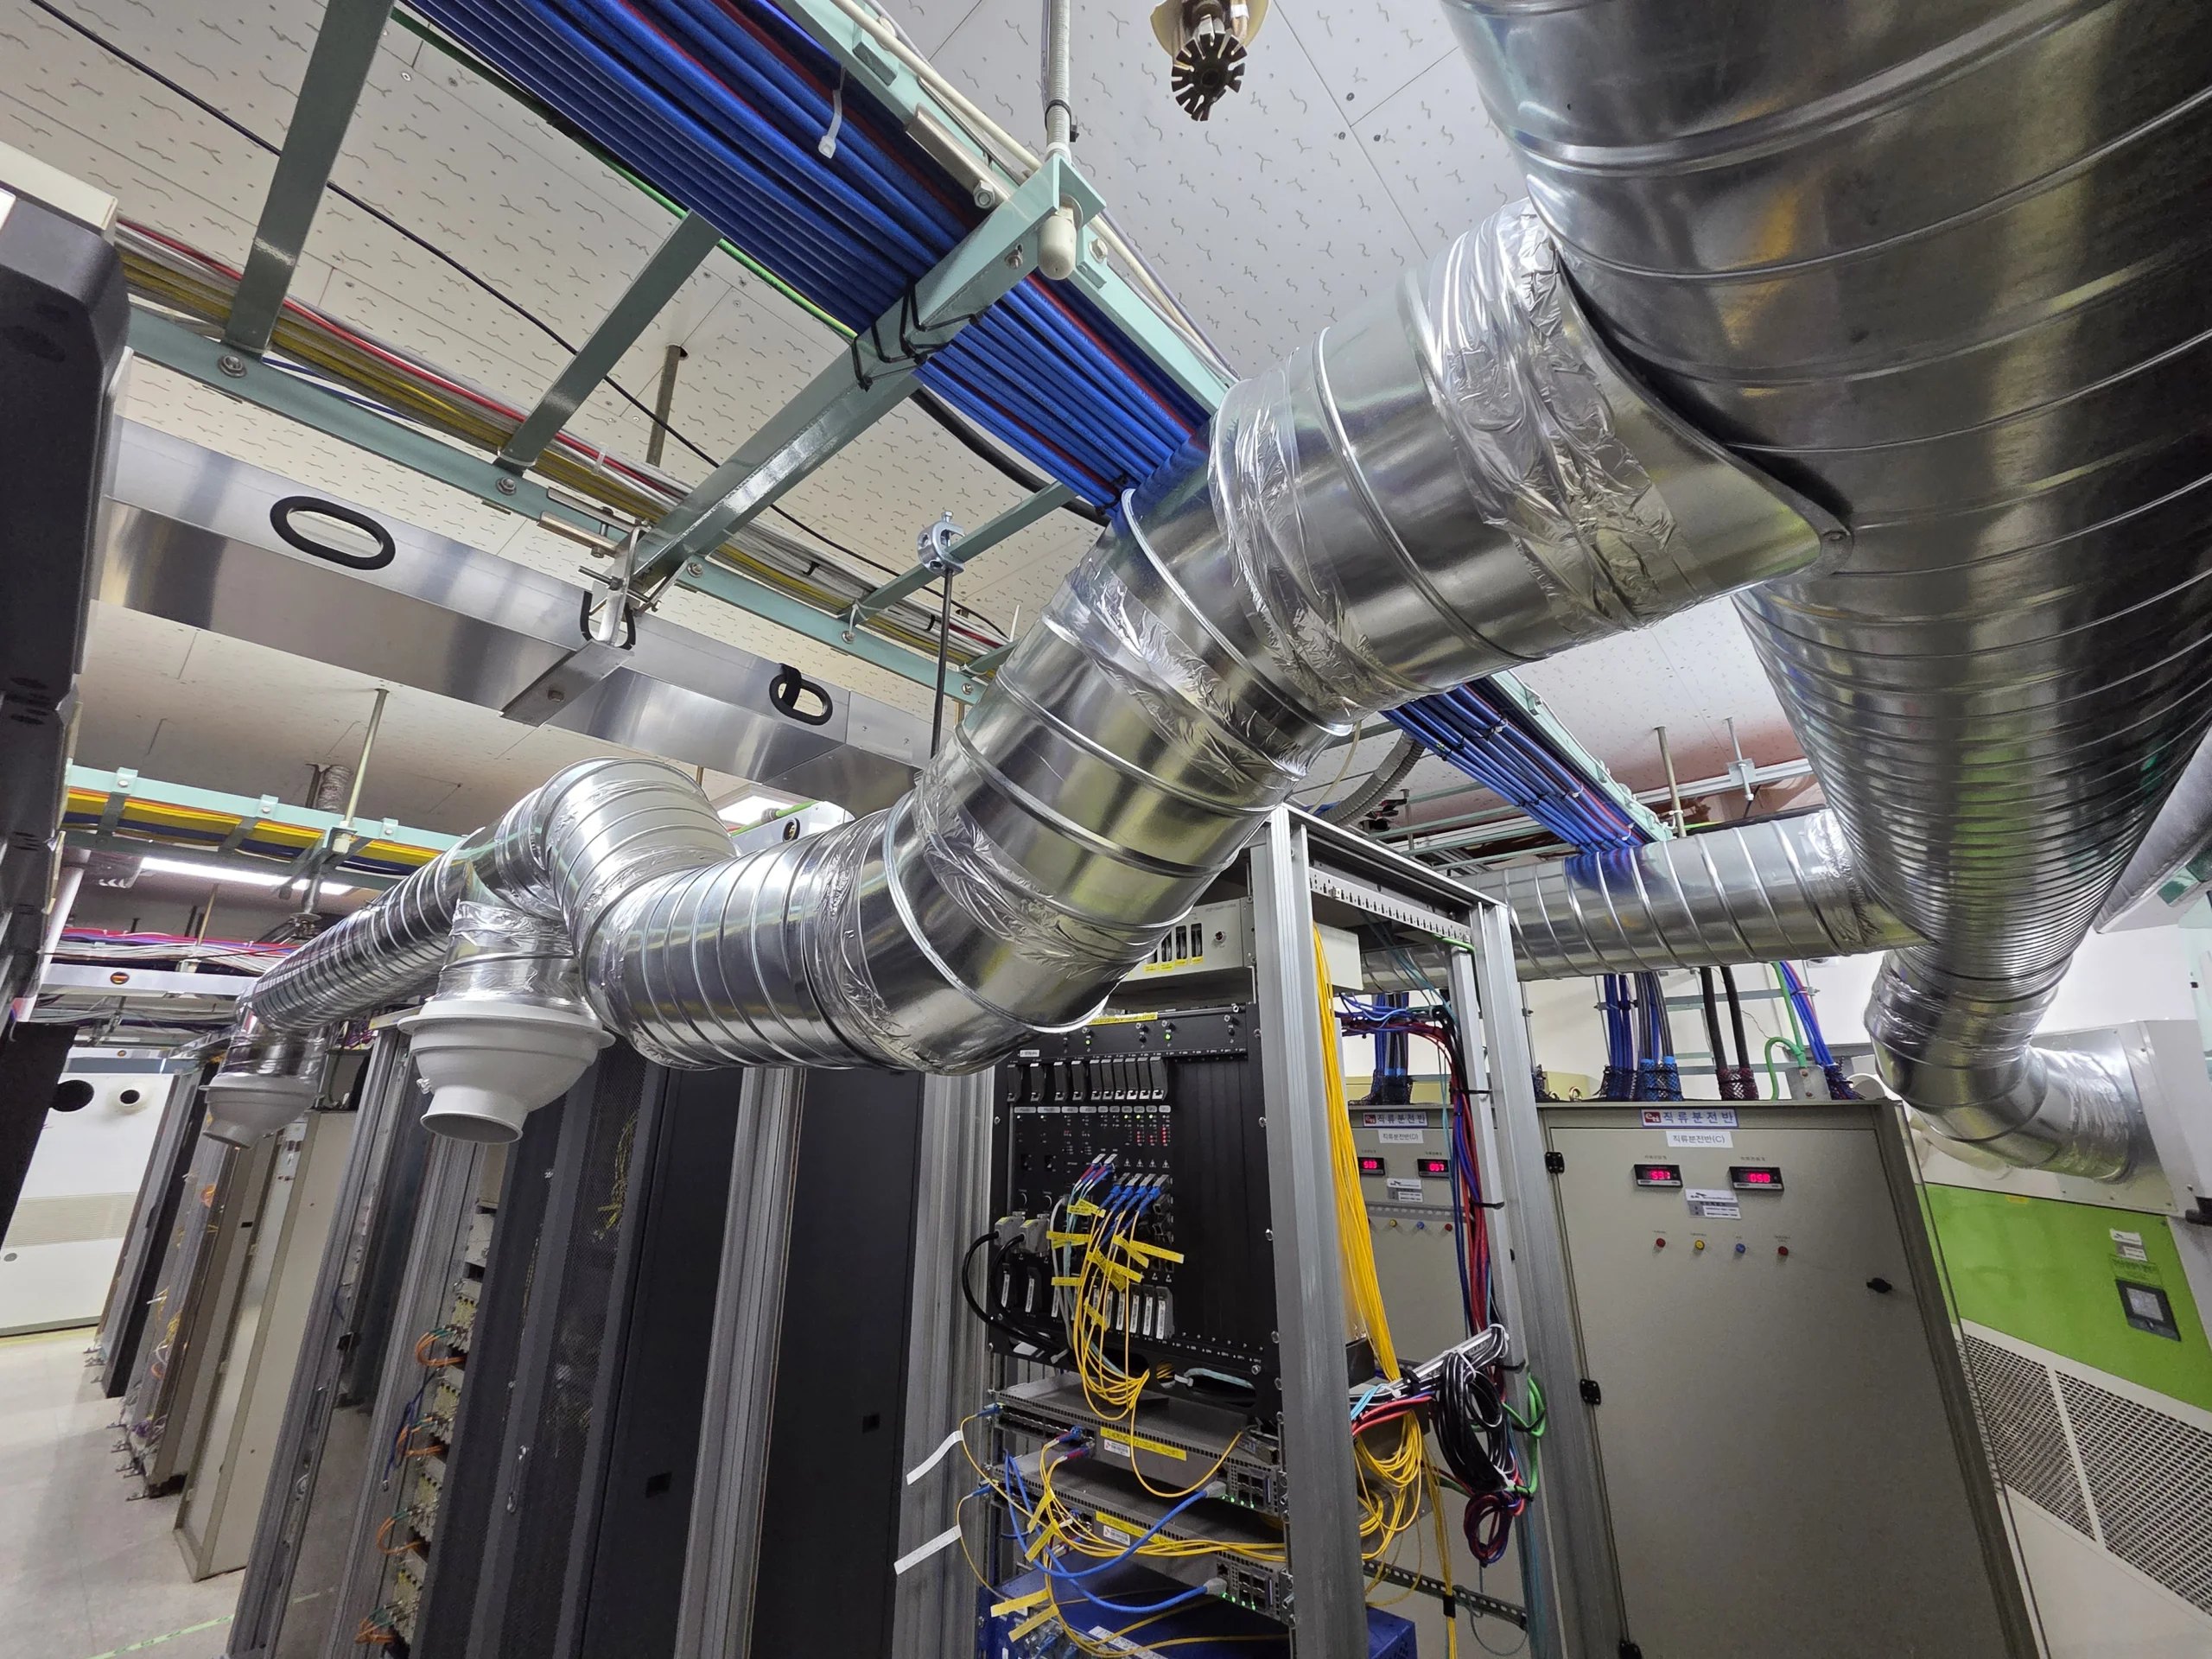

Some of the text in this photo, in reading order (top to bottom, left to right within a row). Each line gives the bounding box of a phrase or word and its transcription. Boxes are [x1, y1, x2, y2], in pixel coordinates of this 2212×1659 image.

[1377, 1113, 1425, 1123] 직류분전반
[1663, 1111, 1733, 1123] 직류분전반
[1673, 1135, 1726, 1144] 직류분전반(C)
